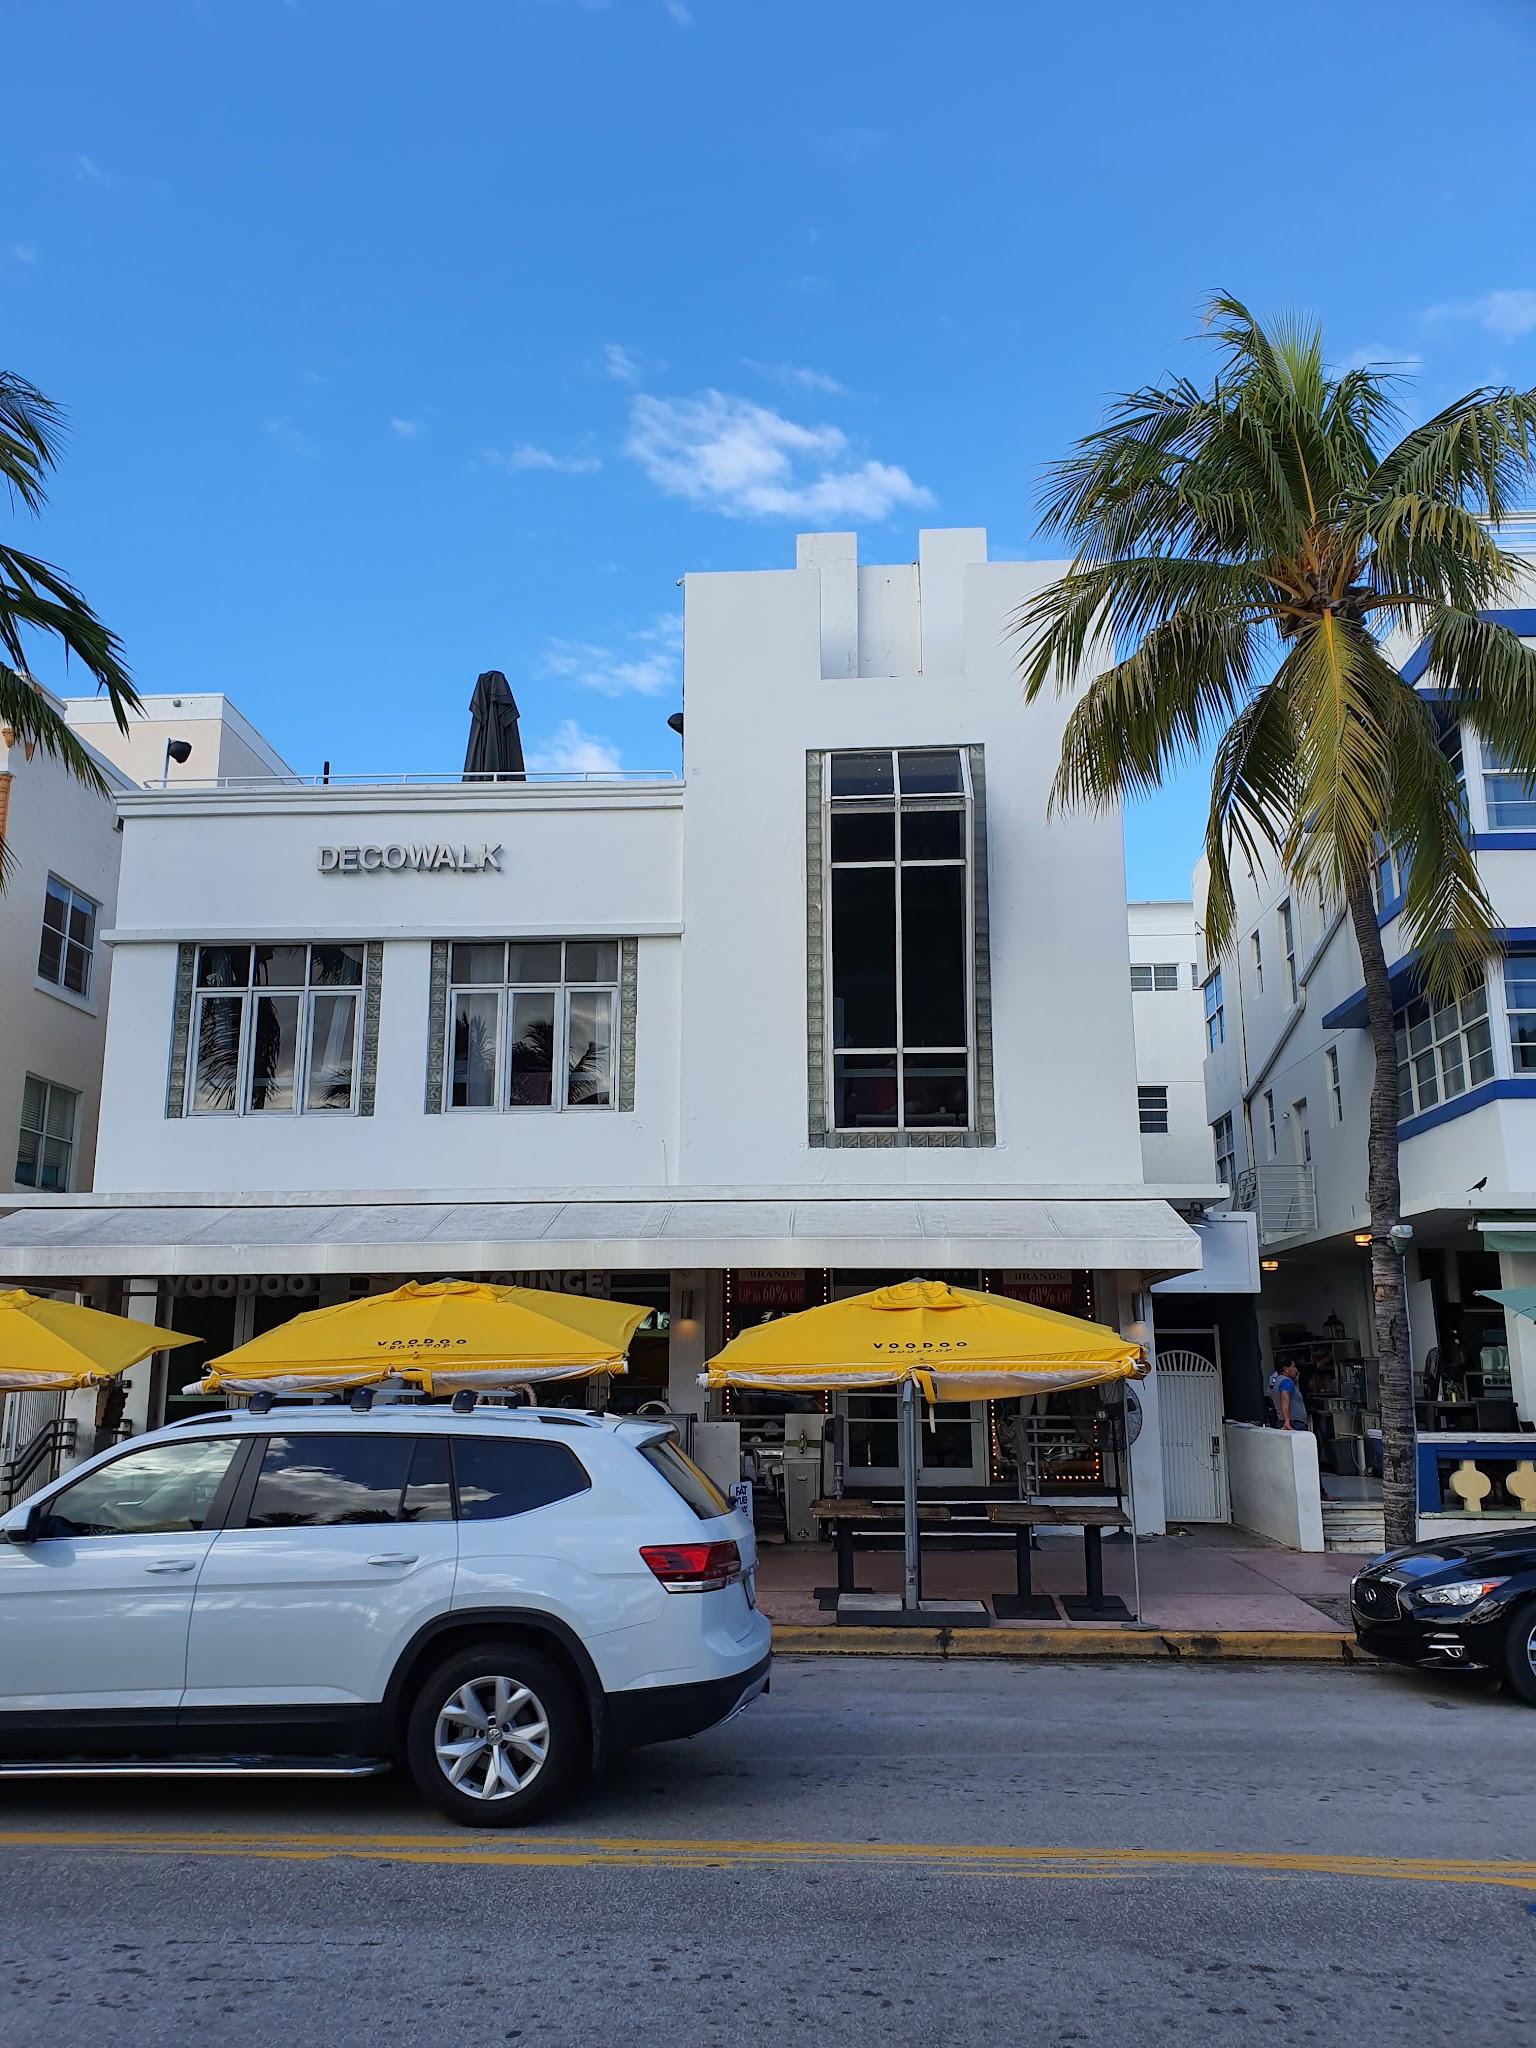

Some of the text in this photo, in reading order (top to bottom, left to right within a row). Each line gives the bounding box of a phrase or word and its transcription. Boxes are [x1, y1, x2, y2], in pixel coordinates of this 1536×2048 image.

[317, 843, 502, 871] DECOWALK
[750, 1270, 797, 1279] BRANDS
[1015, 1272, 1064, 1281] BRANDS
[165, 1275, 310, 1298] VOODOO
[763, 1284, 788, 1302] 60%
[1030, 1286, 1055, 1304] 60%
[377, 1338, 467, 1346] VOODOO
[873, 1341, 968, 1349] VOODOO
